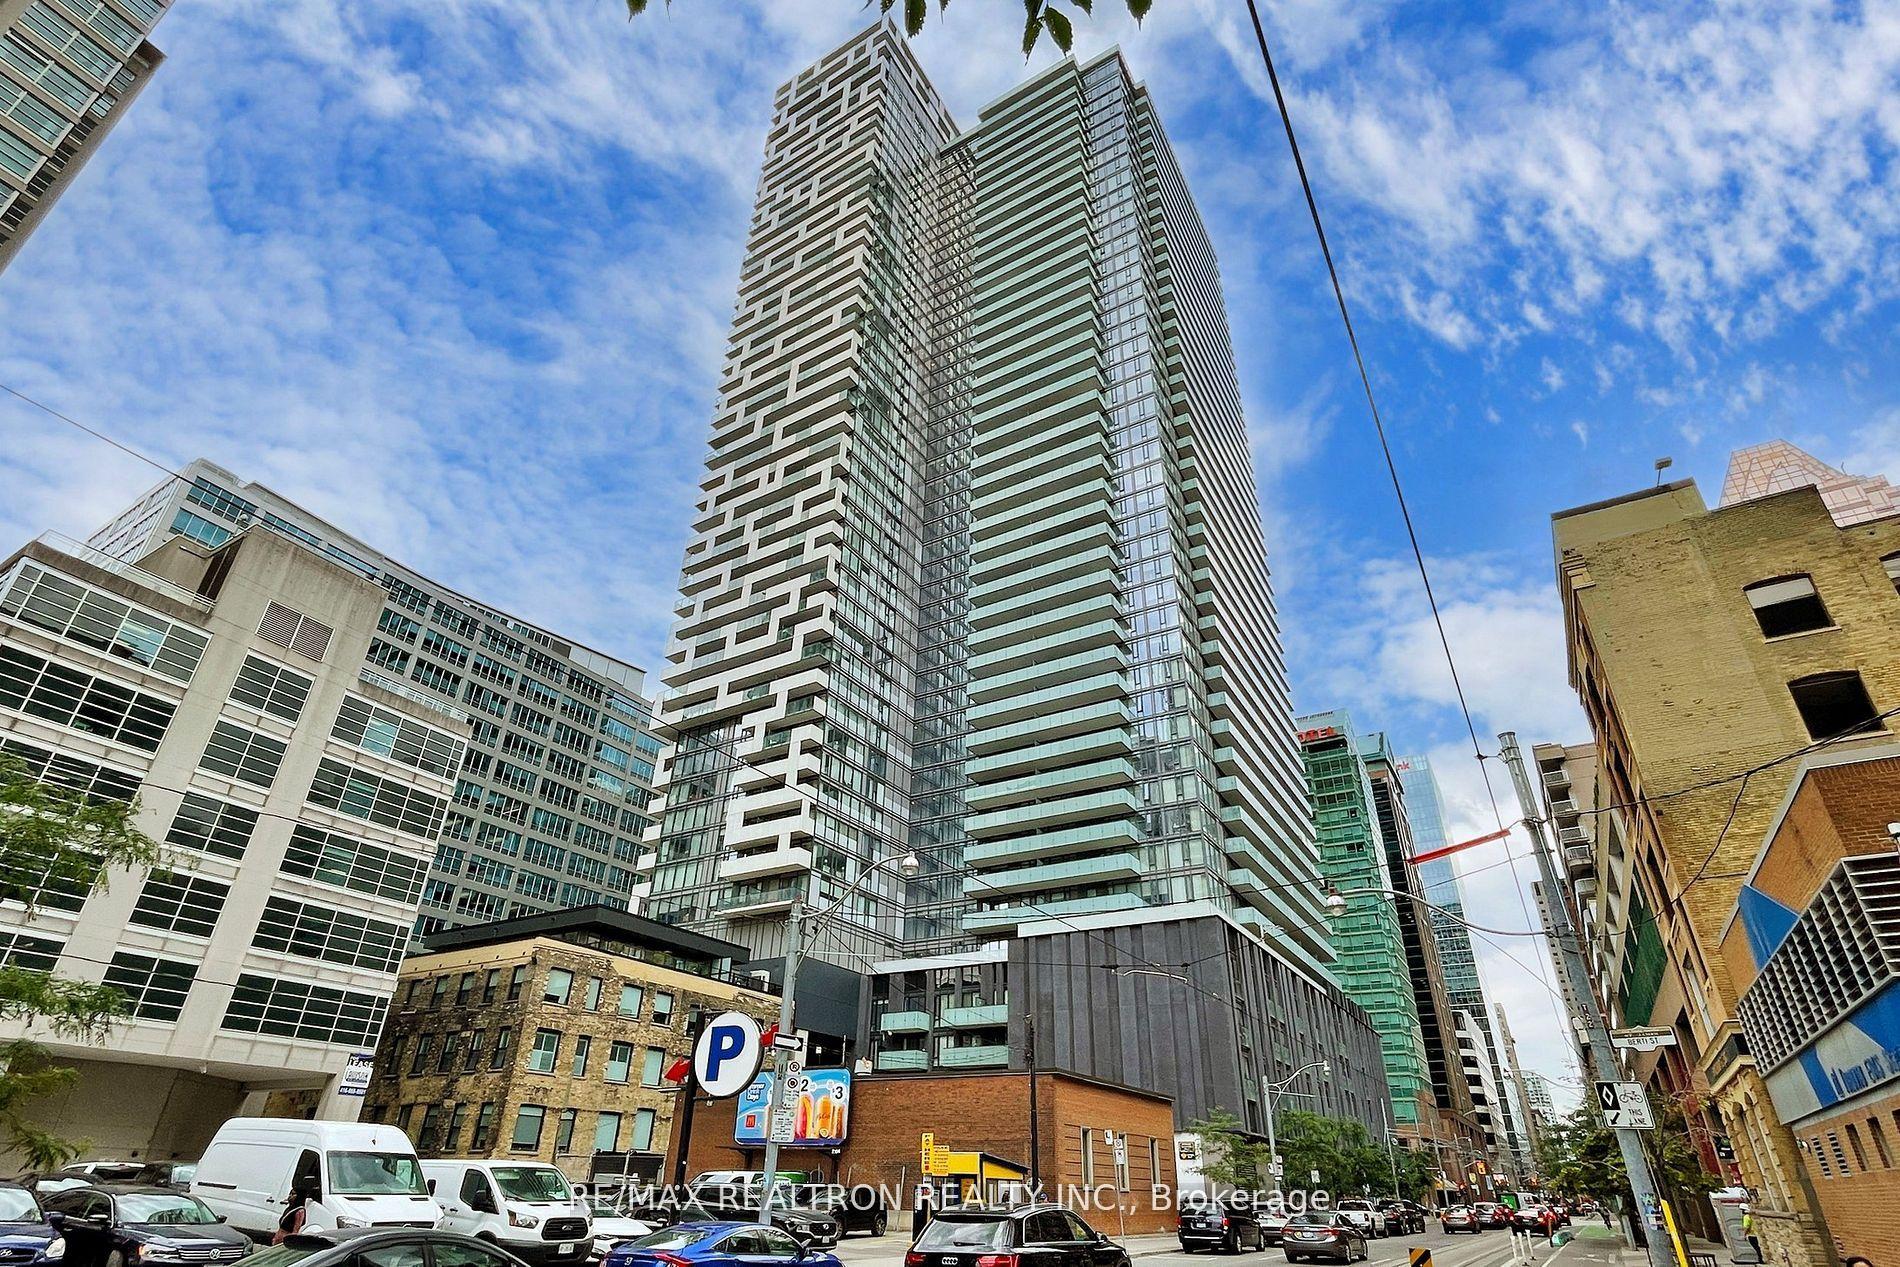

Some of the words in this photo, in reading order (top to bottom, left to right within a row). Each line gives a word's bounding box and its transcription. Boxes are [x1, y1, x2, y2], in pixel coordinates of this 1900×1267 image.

[1296, 726, 1337, 742] OTEL
[1627, 1038, 1648, 1046] BERTI
[1650, 1037, 1659, 1045] ST
[705, 1025, 746, 1082] P
[349, 1060, 374, 1068] LEASE
[1629, 1117, 1647, 1126] LANE
